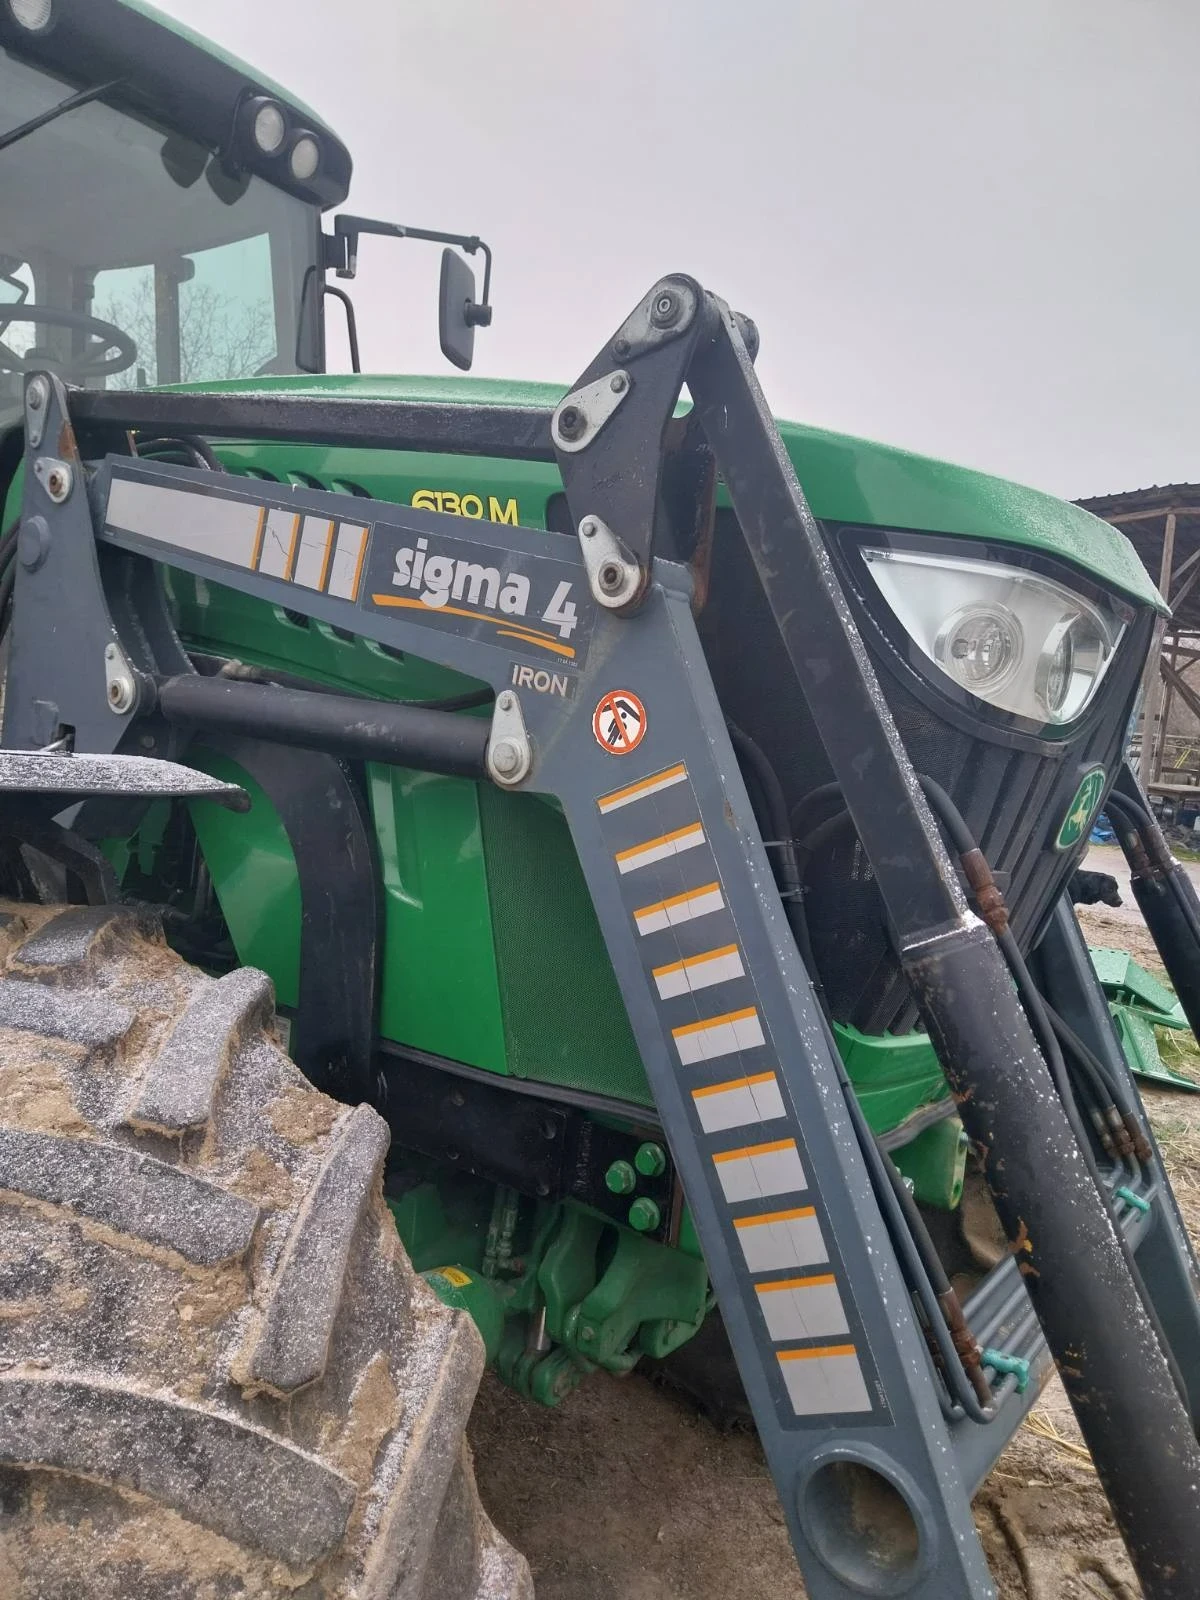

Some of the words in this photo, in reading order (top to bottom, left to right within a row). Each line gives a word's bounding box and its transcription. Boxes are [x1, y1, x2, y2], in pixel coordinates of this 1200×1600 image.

[411, 489, 483, 519] 6130
[489, 496, 518, 526] M
[392, 538, 530, 616] sigma
[541, 581, 577, 638] 4
[512, 664, 568, 697] IRON
